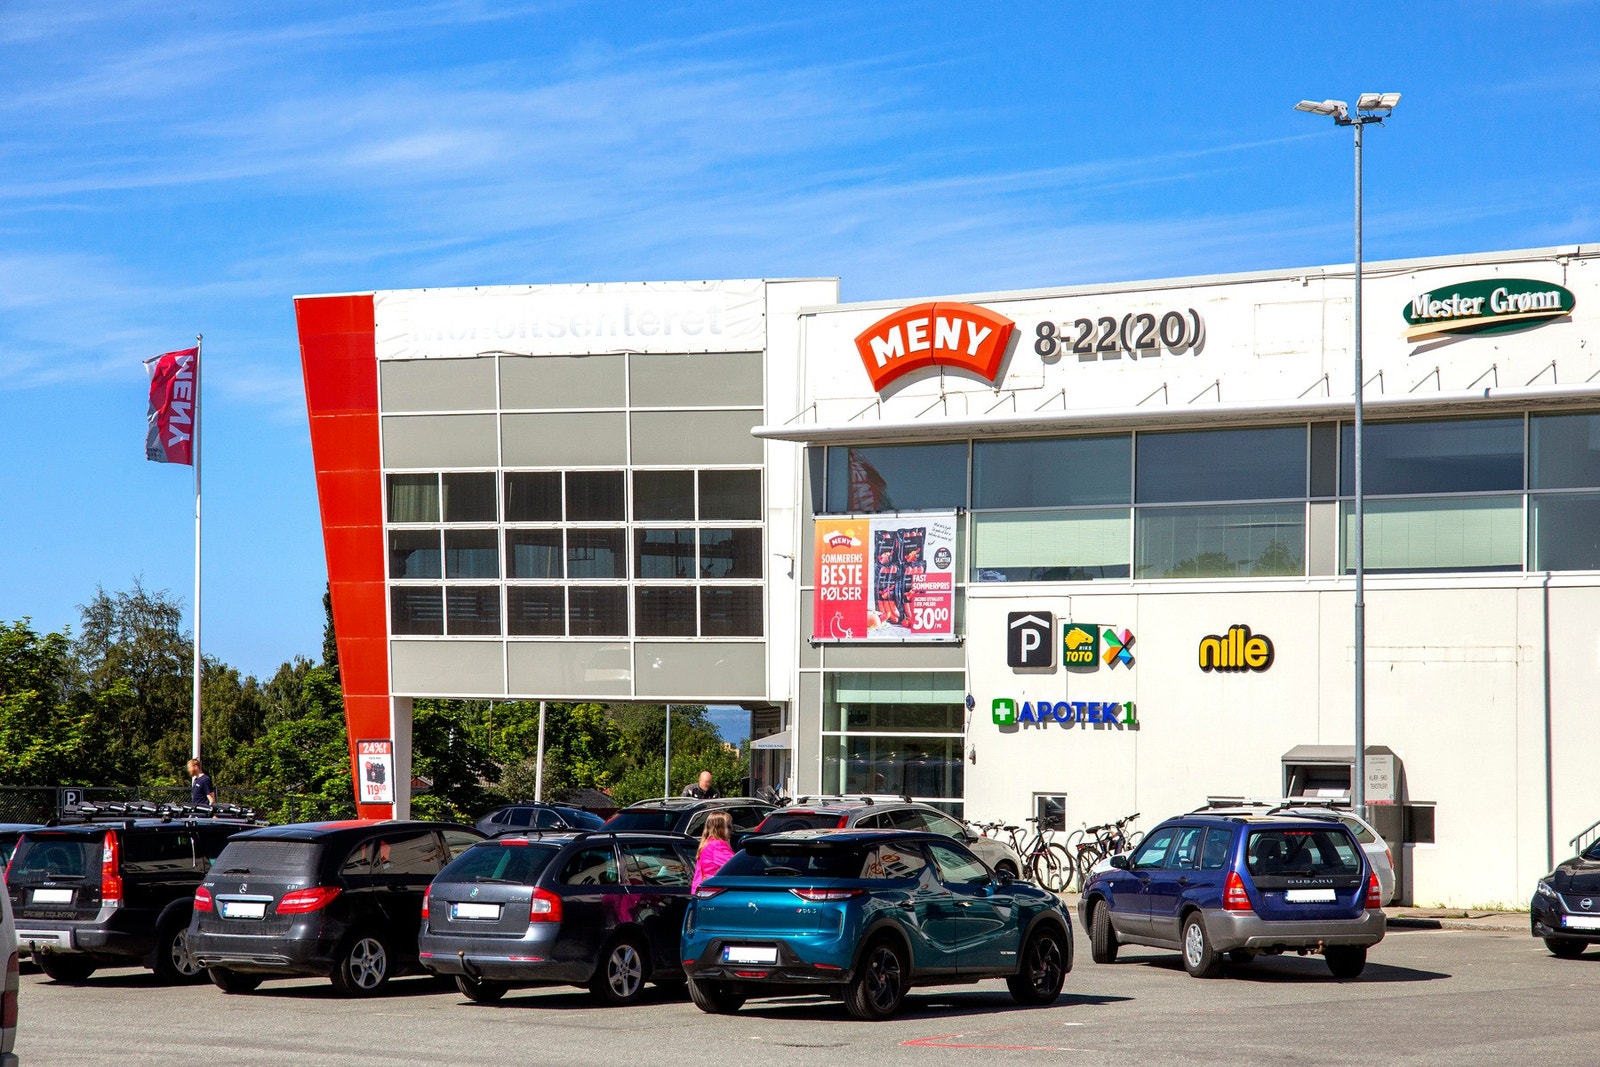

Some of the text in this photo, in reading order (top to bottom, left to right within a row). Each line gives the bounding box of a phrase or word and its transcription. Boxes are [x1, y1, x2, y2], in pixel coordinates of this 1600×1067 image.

[1410, 287, 1562, 319] Mester Grønn
[868, 316, 993, 368] MENY
[1034, 307, 1203, 357] 8-22(20)
[831, 537, 851, 546] MENY
[821, 553, 863, 564] SOMMERENS
[821, 564, 862, 586] BESTE
[912, 574, 927, 582] FAST
[912, 582, 950, 590] SOMMERPRIS
[820, 586, 862, 601] PØLSER
[1021, 628, 1041, 663] P
[1066, 651, 1093, 662] TOTO
[1198, 627, 1270, 668] nille
[1018, 701, 1119, 724] APOTEK
